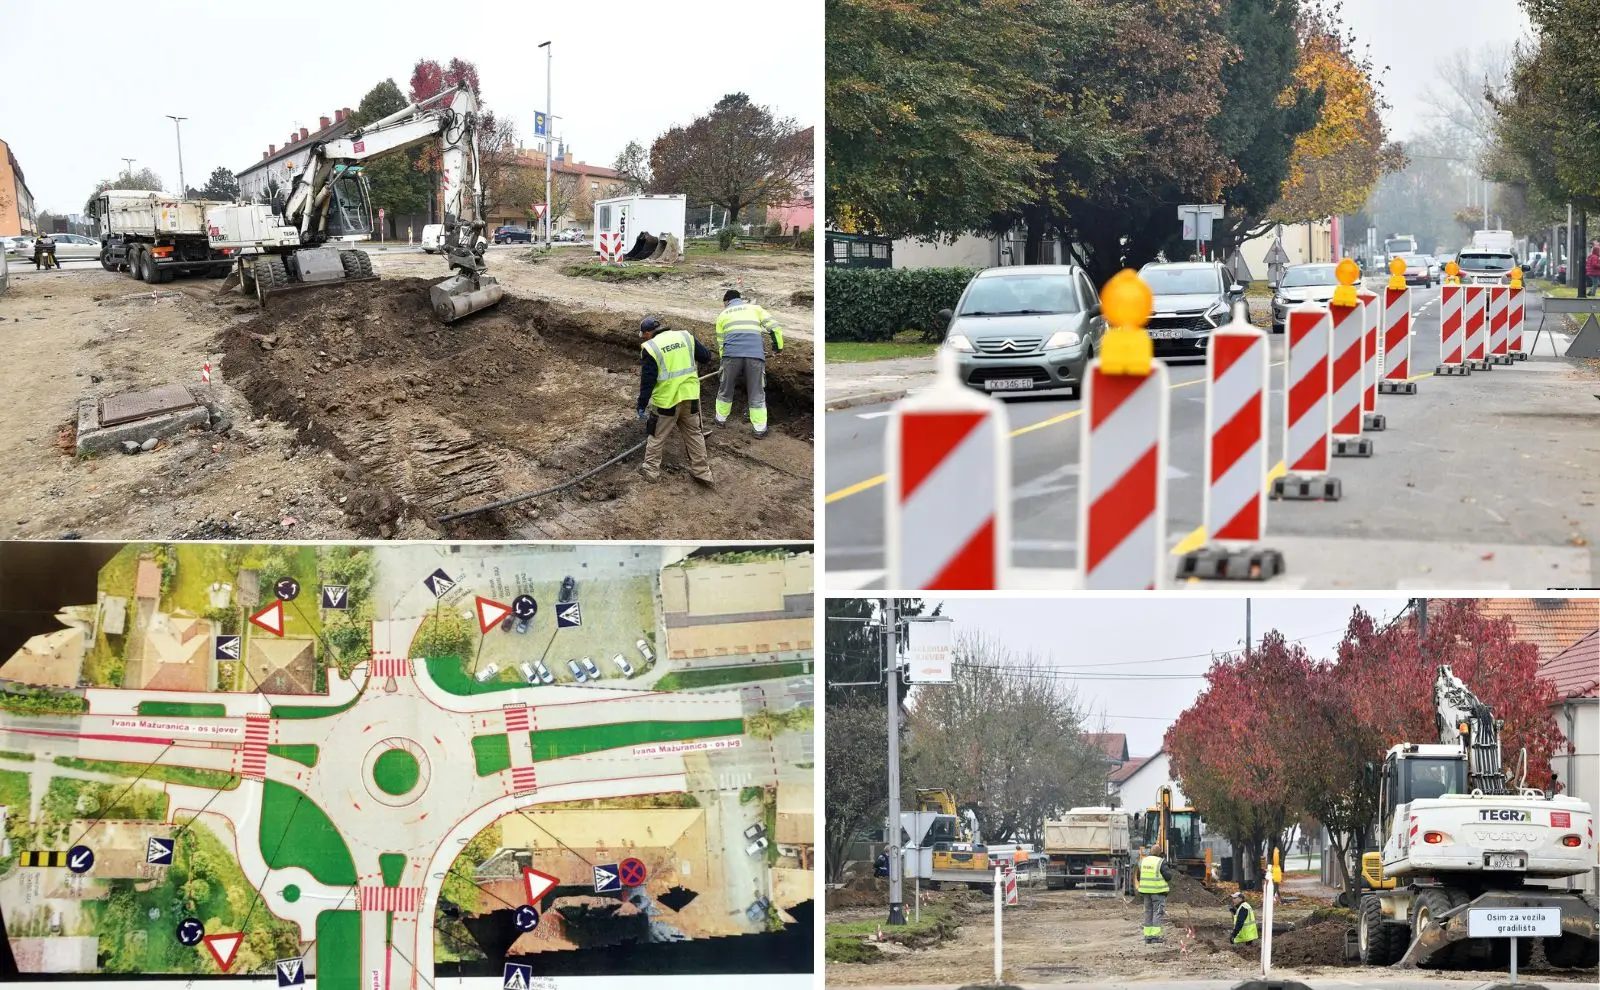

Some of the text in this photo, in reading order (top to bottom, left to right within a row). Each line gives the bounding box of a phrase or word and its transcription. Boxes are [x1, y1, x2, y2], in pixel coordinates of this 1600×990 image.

[661, 342, 687, 353] TEGRA
[112, 719, 136, 727] Ivana
[211, 726, 239, 734] sjever
[1479, 810, 1531, 821] TEGRA
[1474, 831, 1537, 841] VOLVO
